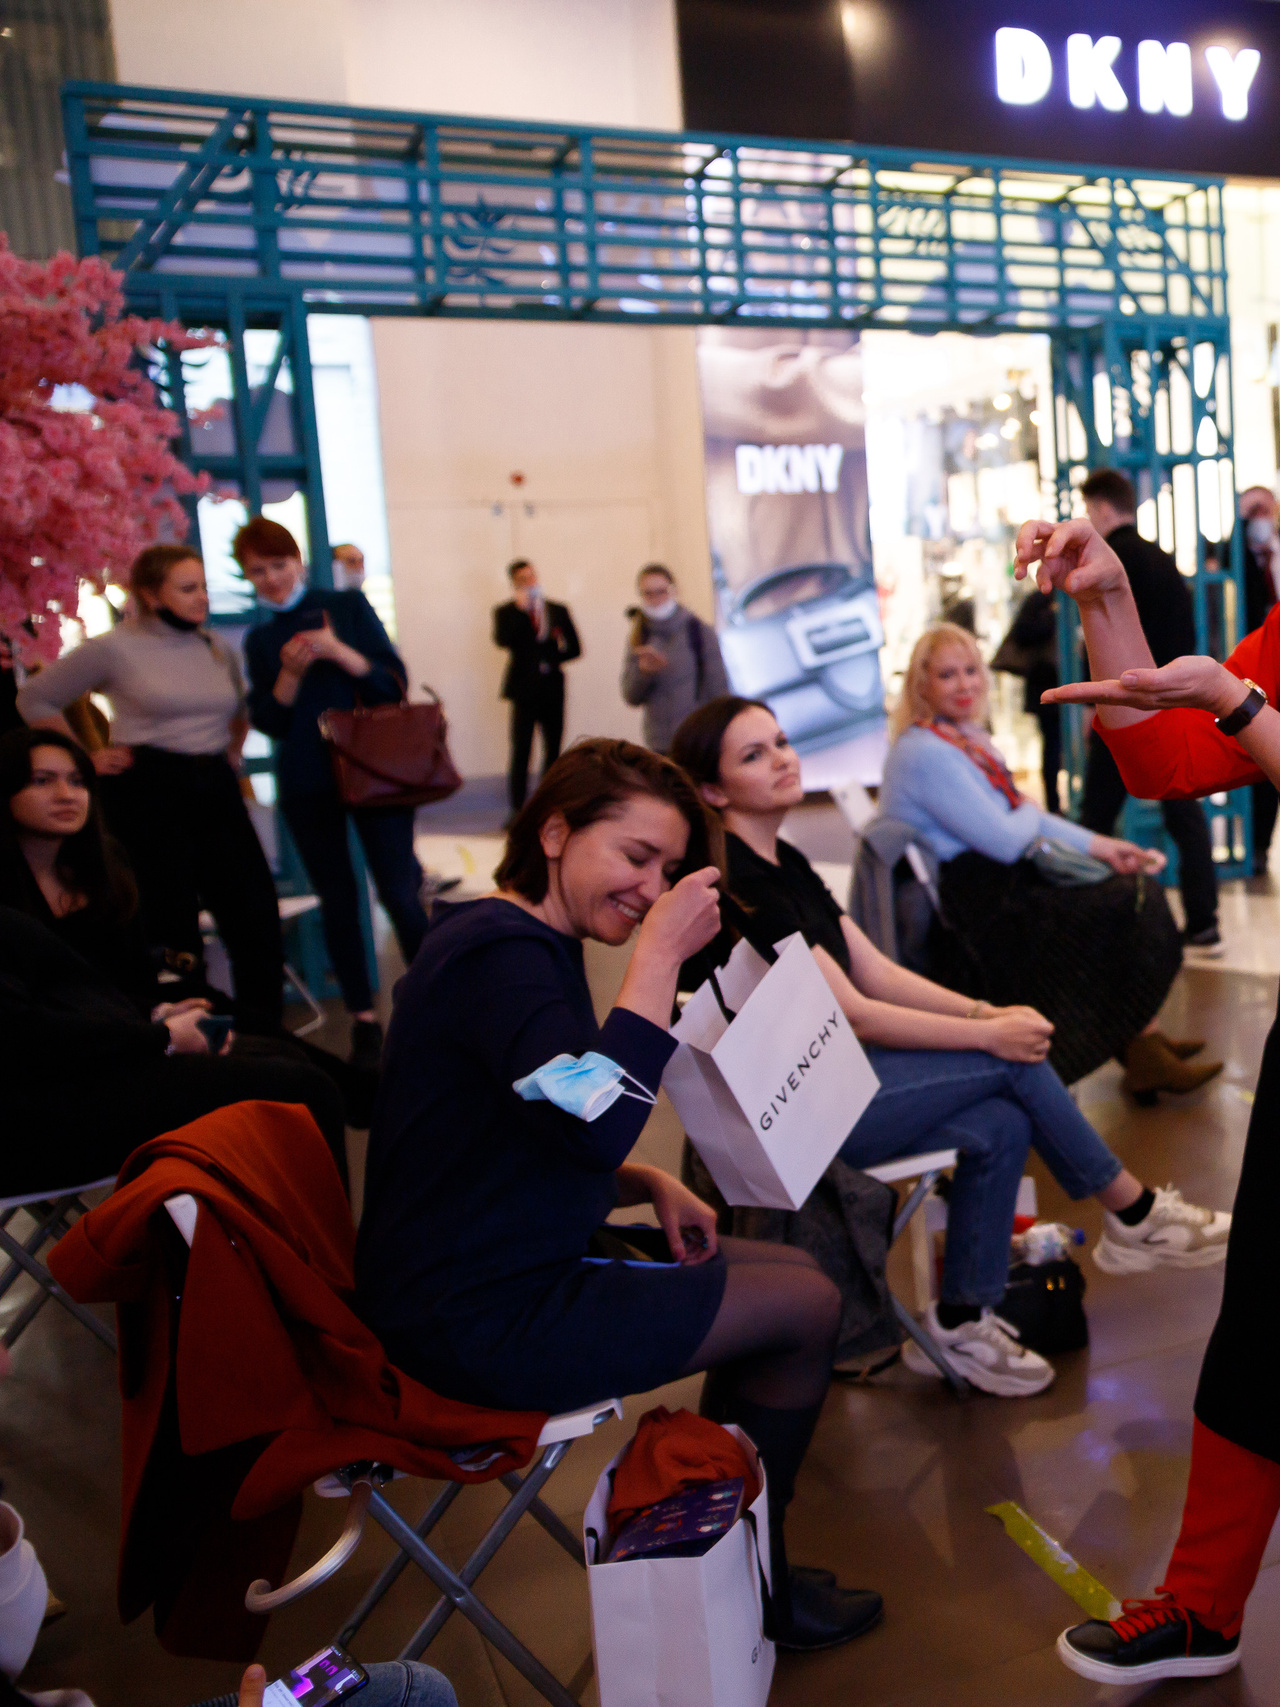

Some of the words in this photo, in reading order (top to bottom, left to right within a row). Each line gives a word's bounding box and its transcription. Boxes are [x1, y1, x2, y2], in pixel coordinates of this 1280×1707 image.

[995, 26, 1262, 121] DKNY
[734, 443, 844, 495] DKNY
[760, 1010, 838, 1131] GIVENCHY
